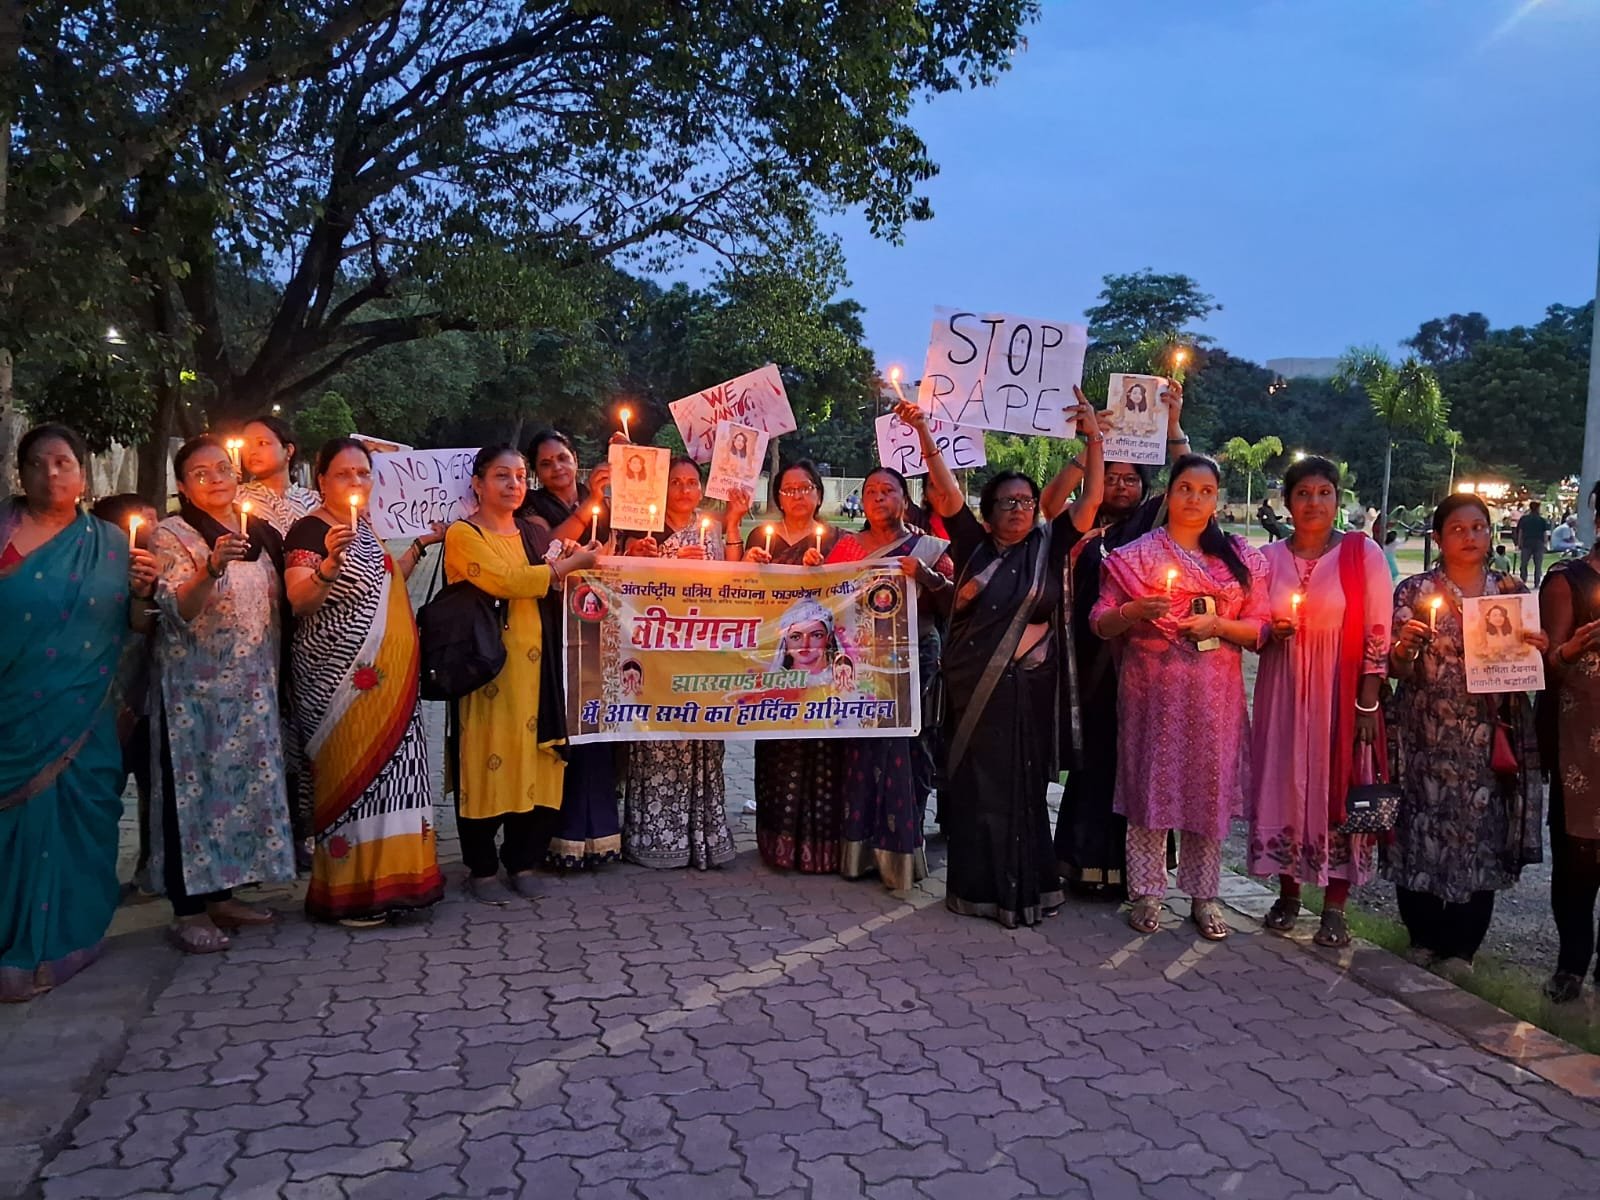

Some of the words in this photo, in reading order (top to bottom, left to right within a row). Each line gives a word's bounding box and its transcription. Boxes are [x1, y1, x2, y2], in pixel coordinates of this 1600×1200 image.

[947, 312, 1063, 383] STOP
[700, 381, 737, 408] WE
[927, 374, 1060, 432] RAPE
[891, 435, 976, 474] RPE
[389, 457, 428, 486] NO
[424, 487, 448, 501] TO
[682, 583, 712, 598] क्षत्रिय
[718, 584, 766, 600] वीरांगना
[631, 606, 762, 649] वीरांगना
[672, 672, 757, 692] झारखण्ड
[761, 667, 809, 690] प्रदेश
[605, 704, 651, 722] आप
[656, 701, 700, 722] सभी
[704, 706, 733, 723] का
[736, 698, 801, 725] हार्दिक
[804, 696, 896, 719] अभिनंदन
